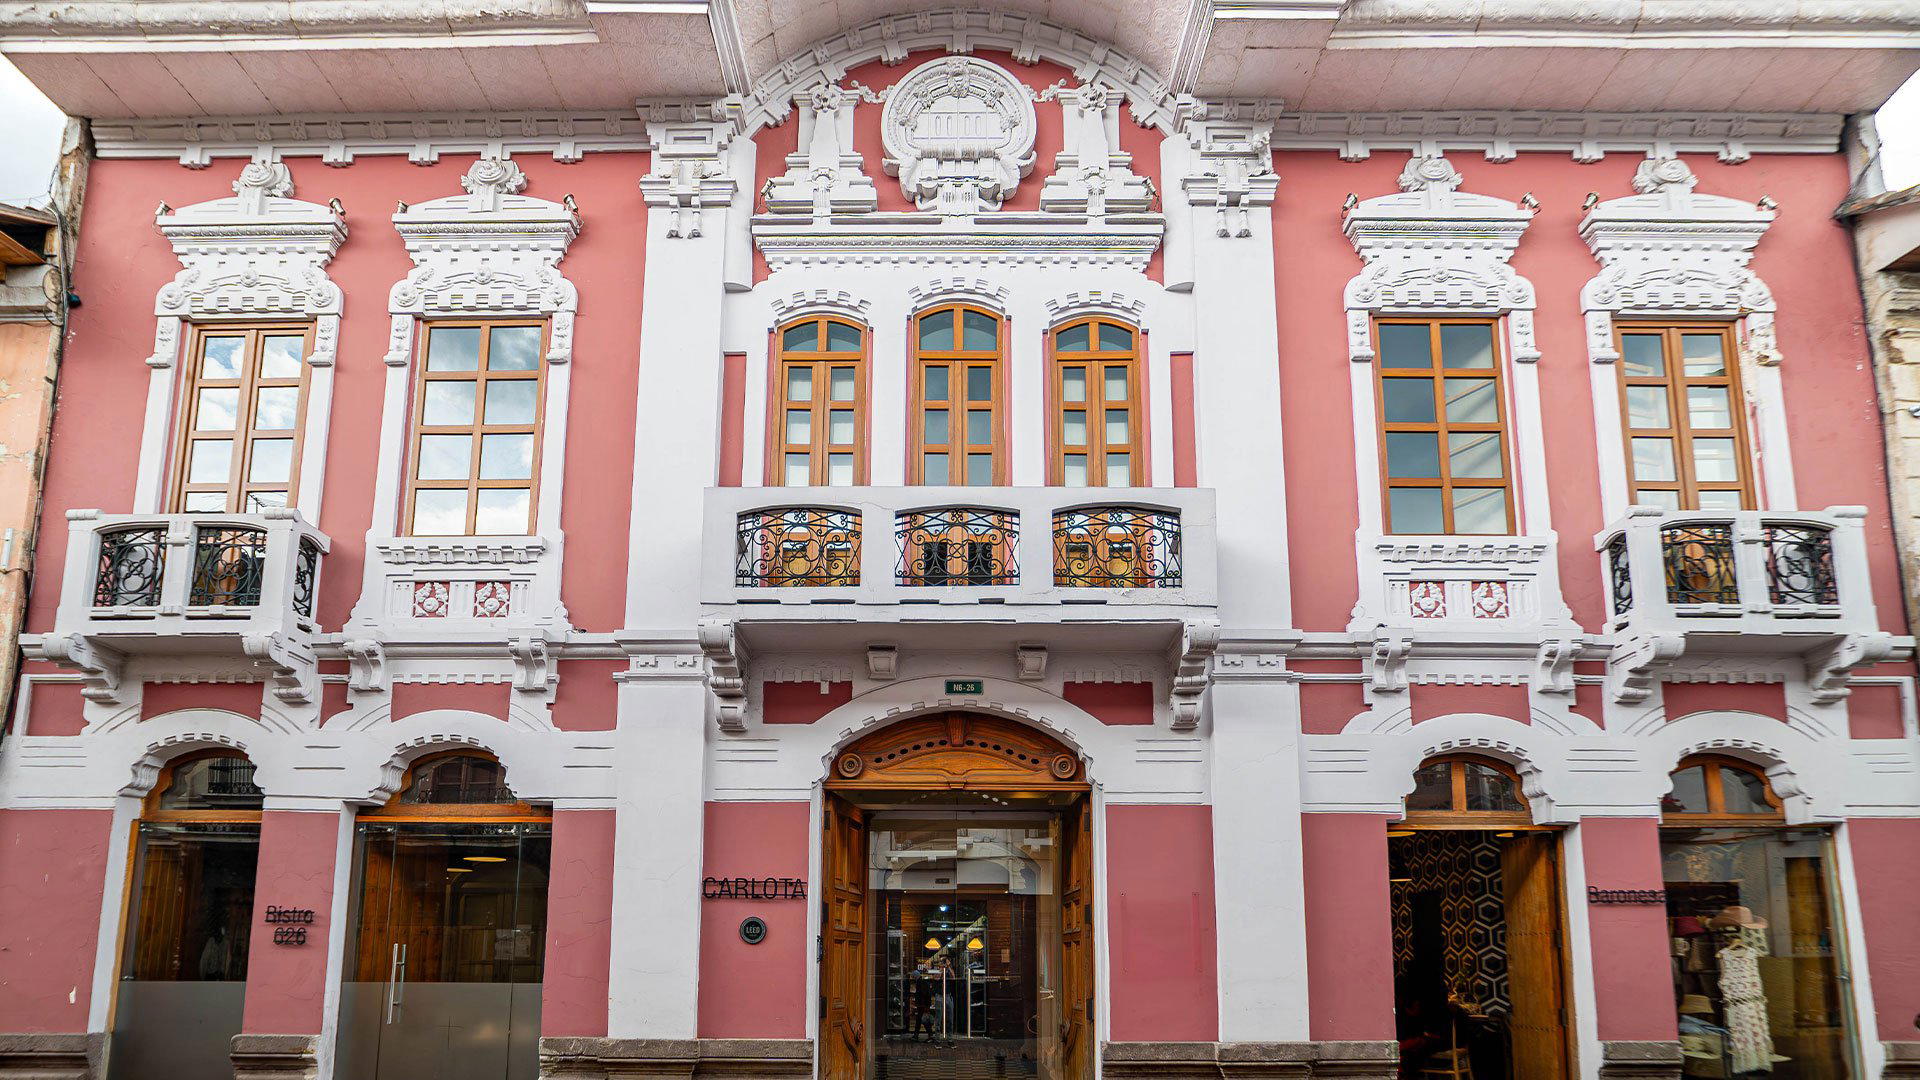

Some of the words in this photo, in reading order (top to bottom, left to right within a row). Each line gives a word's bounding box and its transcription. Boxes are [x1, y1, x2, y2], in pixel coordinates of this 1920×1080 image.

[953, 683, 975, 692] N6-26
[702, 877, 806, 900] CARLOTA
[1588, 886, 1667, 904] Baronesa
[265, 905, 314, 923] Bistro
[273, 927, 306, 945] 626
